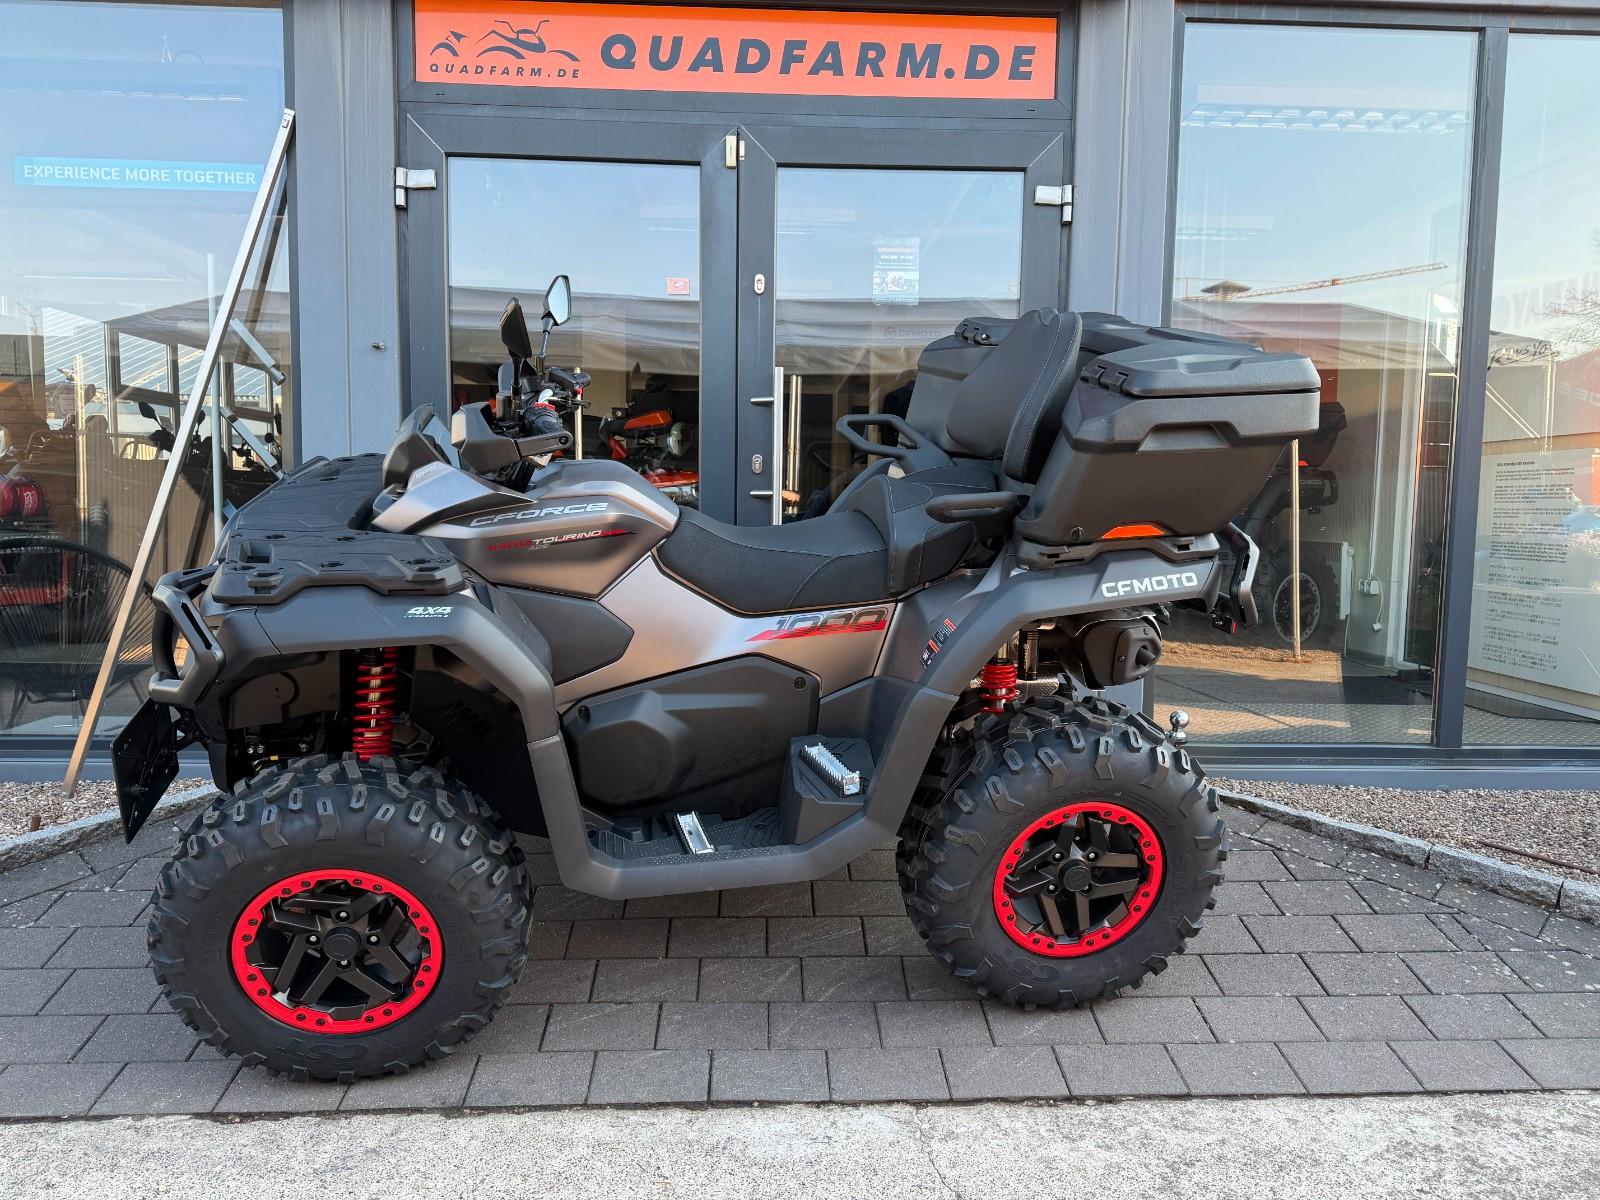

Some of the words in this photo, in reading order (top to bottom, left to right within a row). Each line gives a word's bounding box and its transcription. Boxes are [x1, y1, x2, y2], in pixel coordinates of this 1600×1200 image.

[600, 33, 1036, 81] QUADFARM.DE
[429, 63, 580, 79] QUADFARM.DE
[23, 164, 121, 181] EXPERIENCE
[125, 168, 170, 182] MORE
[175, 169, 256, 185] TOGETHER
[470, 502, 609, 527] CFORCE
[1101, 572, 1198, 598] CFMOTO
